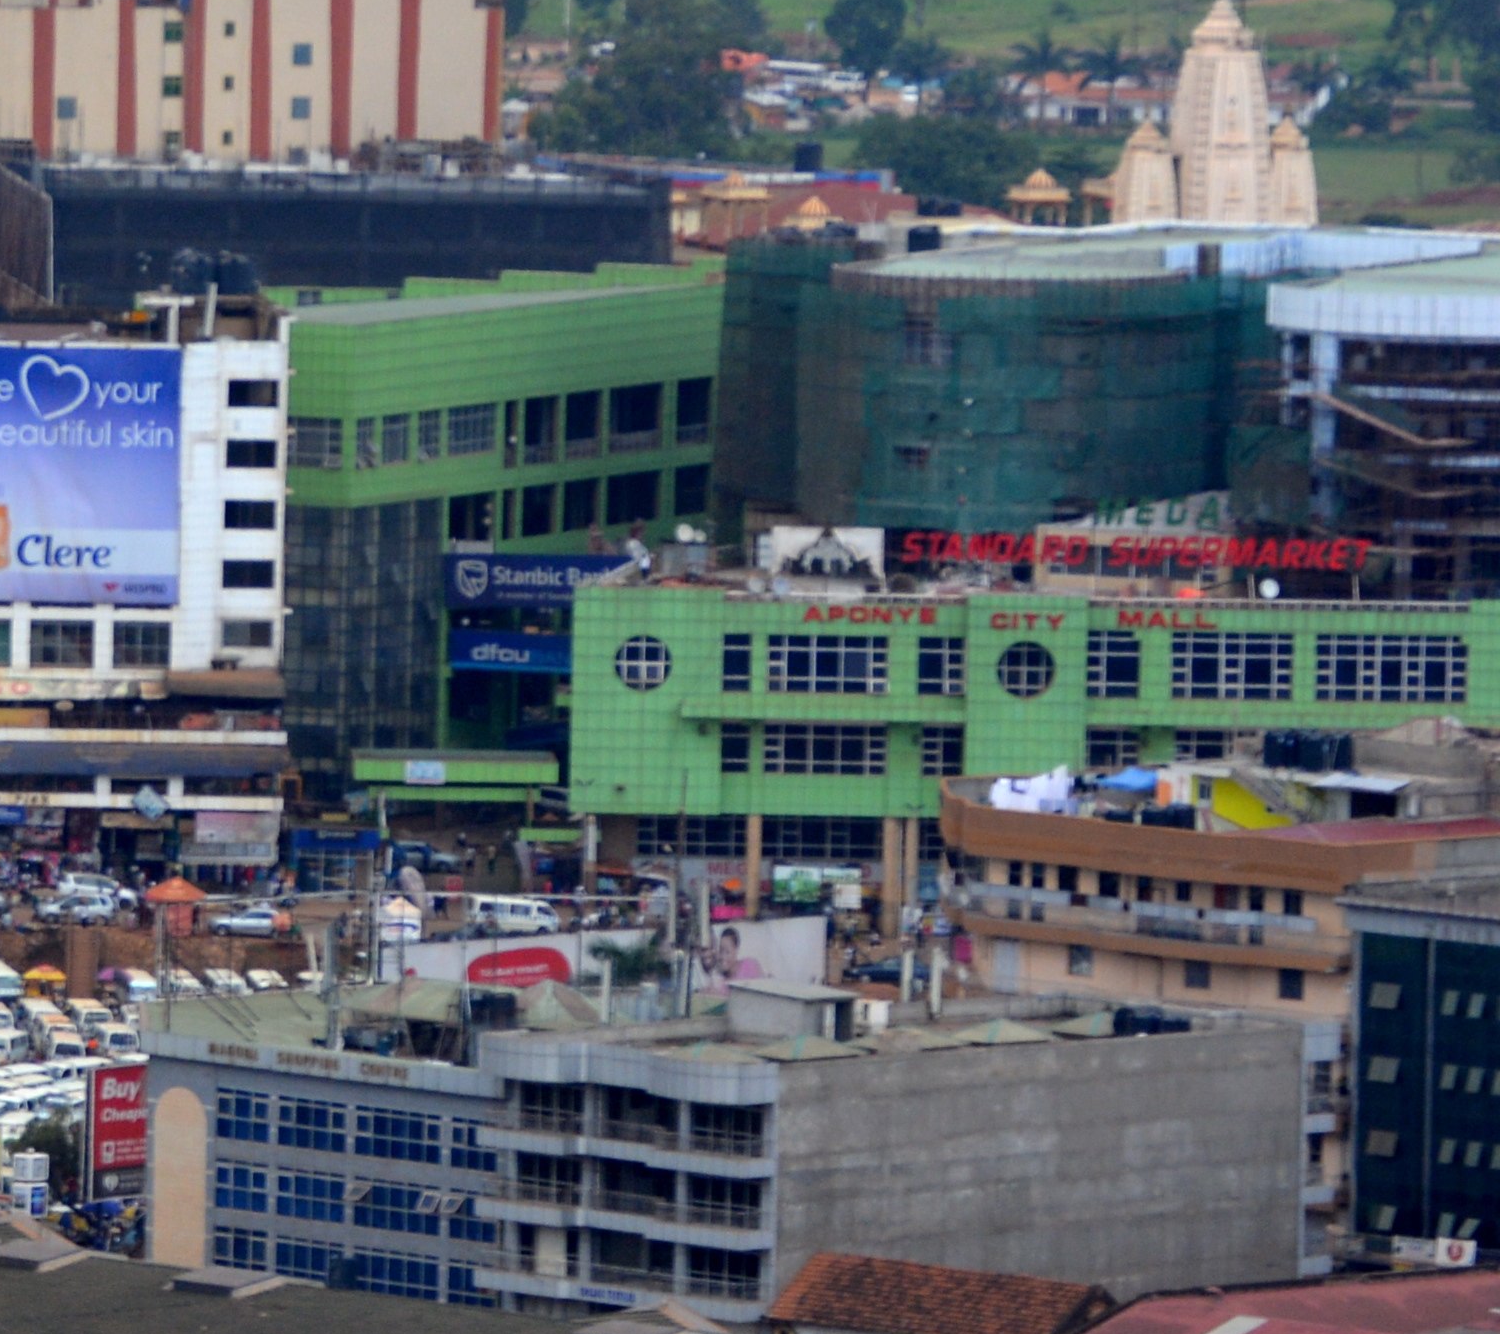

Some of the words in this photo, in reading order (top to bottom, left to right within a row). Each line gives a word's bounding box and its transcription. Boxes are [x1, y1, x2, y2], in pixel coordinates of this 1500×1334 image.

[95, 380, 163, 409] your
[119, 420, 174, 448] skin
[16, 534, 112, 568] Clere
[900, 531, 1089, 566] STANDARD
[1109, 536, 1373, 571] SUPERMARKET
[492, 566, 562, 586] Stanbic
[803, 605, 938, 625] APONYE
[990, 613, 1065, 631] CITY
[1117, 610, 1218, 629] MALL
[102, 1078, 141, 1102] Buy
